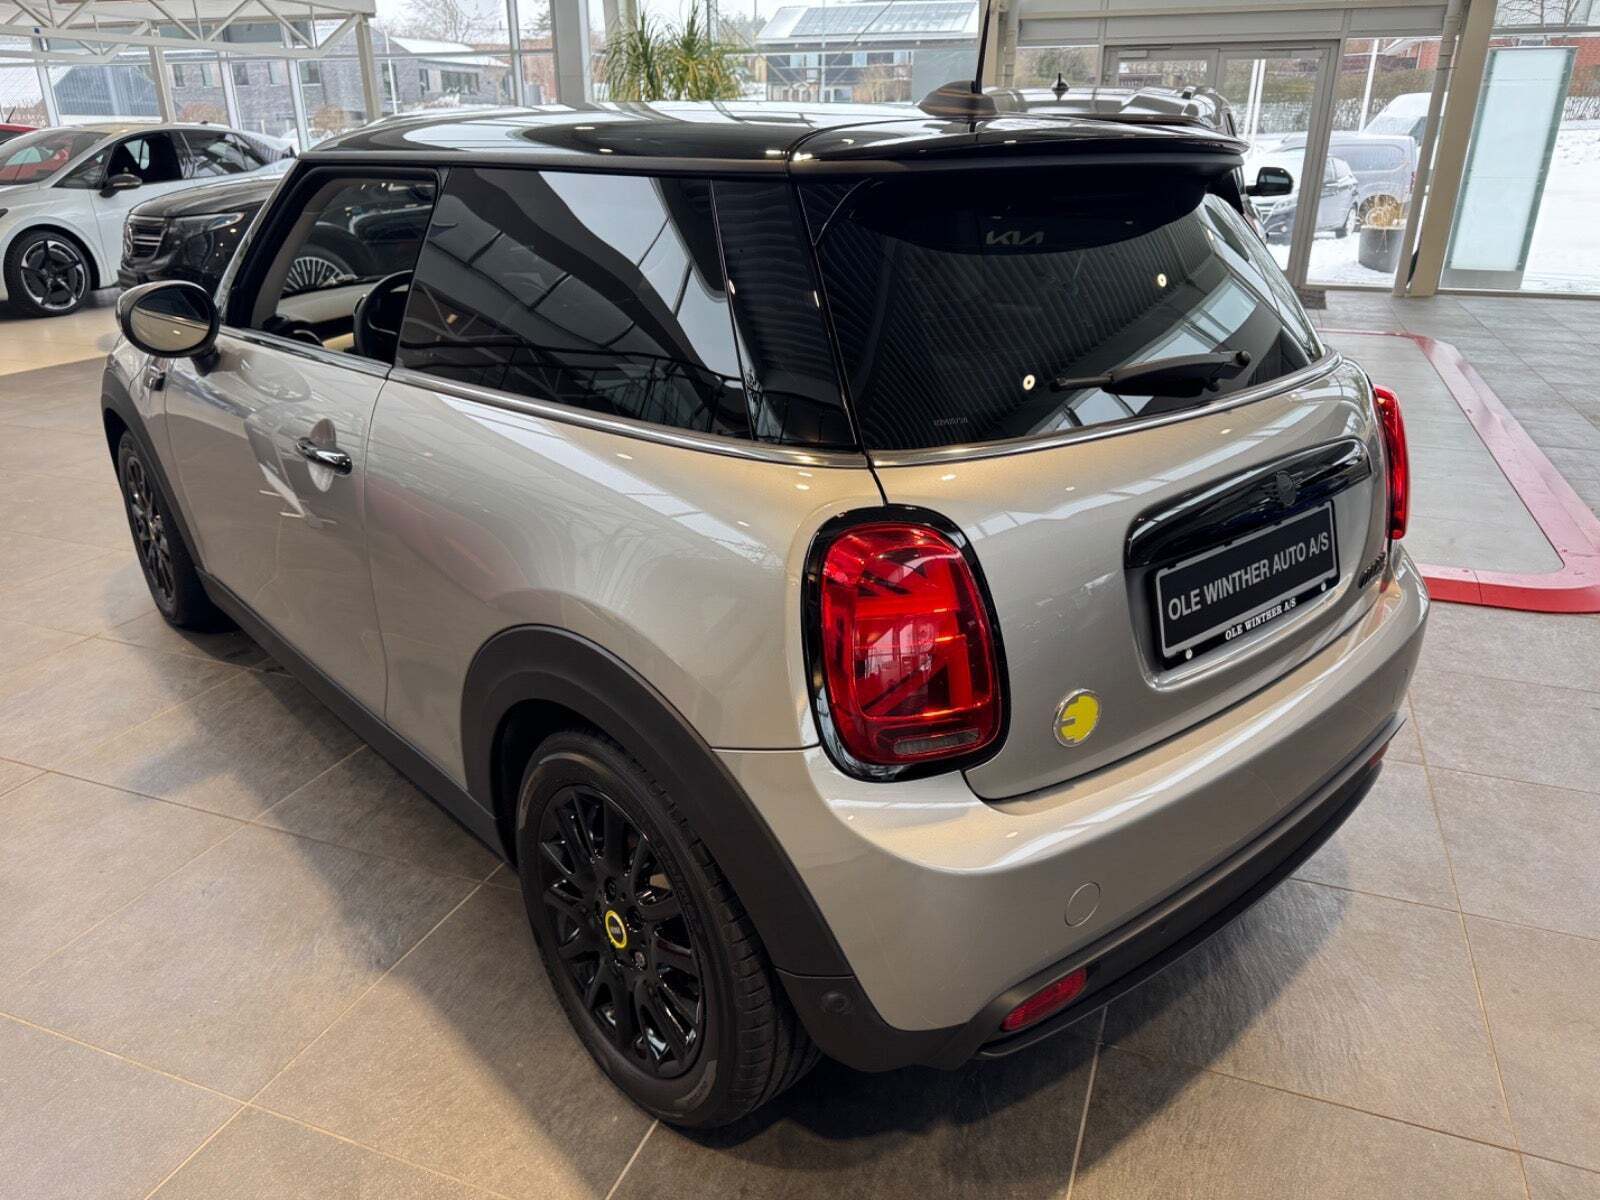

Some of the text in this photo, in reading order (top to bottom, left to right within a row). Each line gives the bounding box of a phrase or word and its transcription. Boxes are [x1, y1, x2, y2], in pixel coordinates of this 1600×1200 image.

[986, 230, 1045, 245] KIA
[1167, 531, 1330, 621] OLE WINTHER AUTO A/S
[1225, 597, 1297, 641] OLE WINTHER A/S
